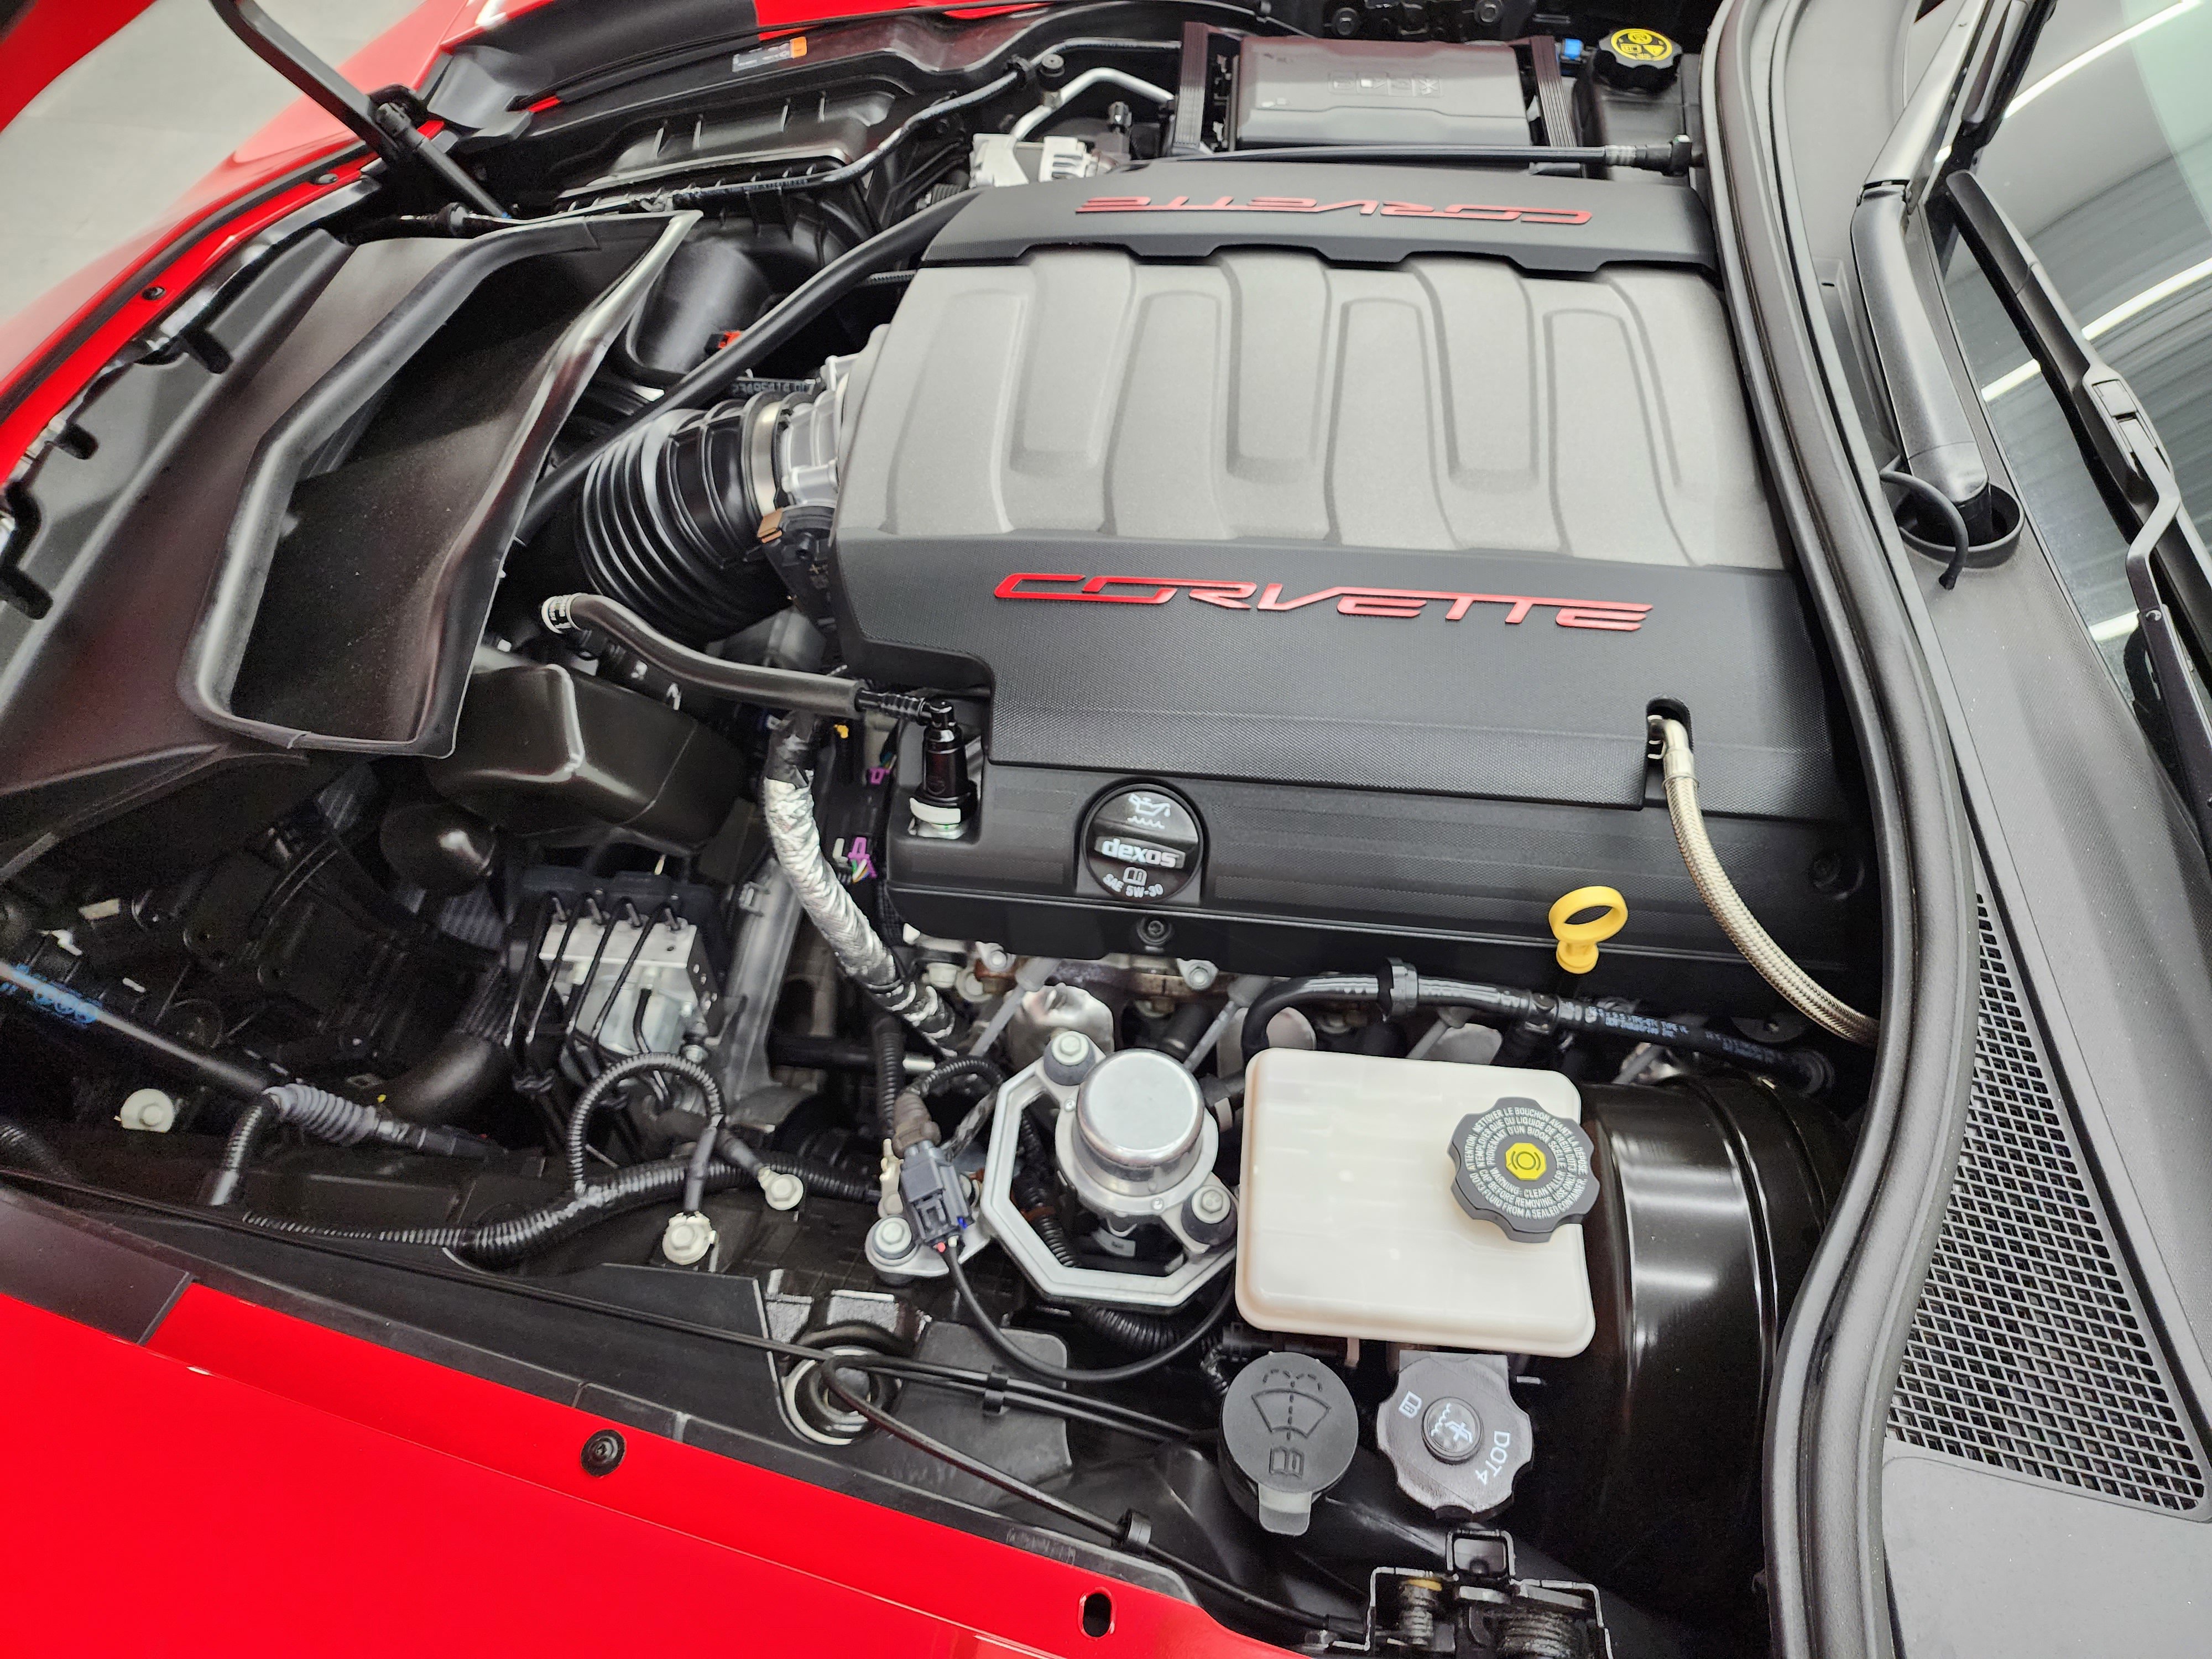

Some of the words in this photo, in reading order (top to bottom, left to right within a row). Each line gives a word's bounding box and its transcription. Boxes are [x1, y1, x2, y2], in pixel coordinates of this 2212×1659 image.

[1075, 196, 1593, 225] CORVETTE
[993, 572, 1655, 632] CORVETTE
[1101, 838, 1180, 868] dexos
[1103, 873, 1124, 893] SAE
[1125, 884, 1164, 898] 5W-30
[1472, 1109, 1504, 1134] NETTOYER
[1503, 1107, 1515, 1117] LE
[1514, 1107, 1551, 1123] BOUCHON
[1549, 1118, 1573, 1137] AVANT
[1567, 1136, 1580, 1147] LA
[1489, 1119, 1505, 1134] QUE
[1504, 1117, 1515, 1126] DU
[1515, 1116, 1547, 1131] LIQUIDE
[1545, 1124, 1558, 1137] DE
[1553, 1133, 1574, 1154] FREIN
[1486, 1129, 1508, 1167] PROVENANT
[1506, 1125, 1526, 1136] D'UN
[1527, 1126, 1551, 1144] BIDON
[1479, 1169, 1493, 1183] CAP
[1487, 1181, 1516, 1204] BEFORE
[1552, 1186, 1570, 1203] USE
[1562, 1172, 1577, 1192] ONLY
[1524, 1186, 1550, 1199] CLEAN
[1546, 1170, 1567, 1194] FILLER
[1481, 1188, 1505, 1209] FLUID
[1501, 1202, 1526, 1219] FROM
[1525, 1209, 1532, 1220] A
[1531, 1204, 1561, 1220] SEALED
